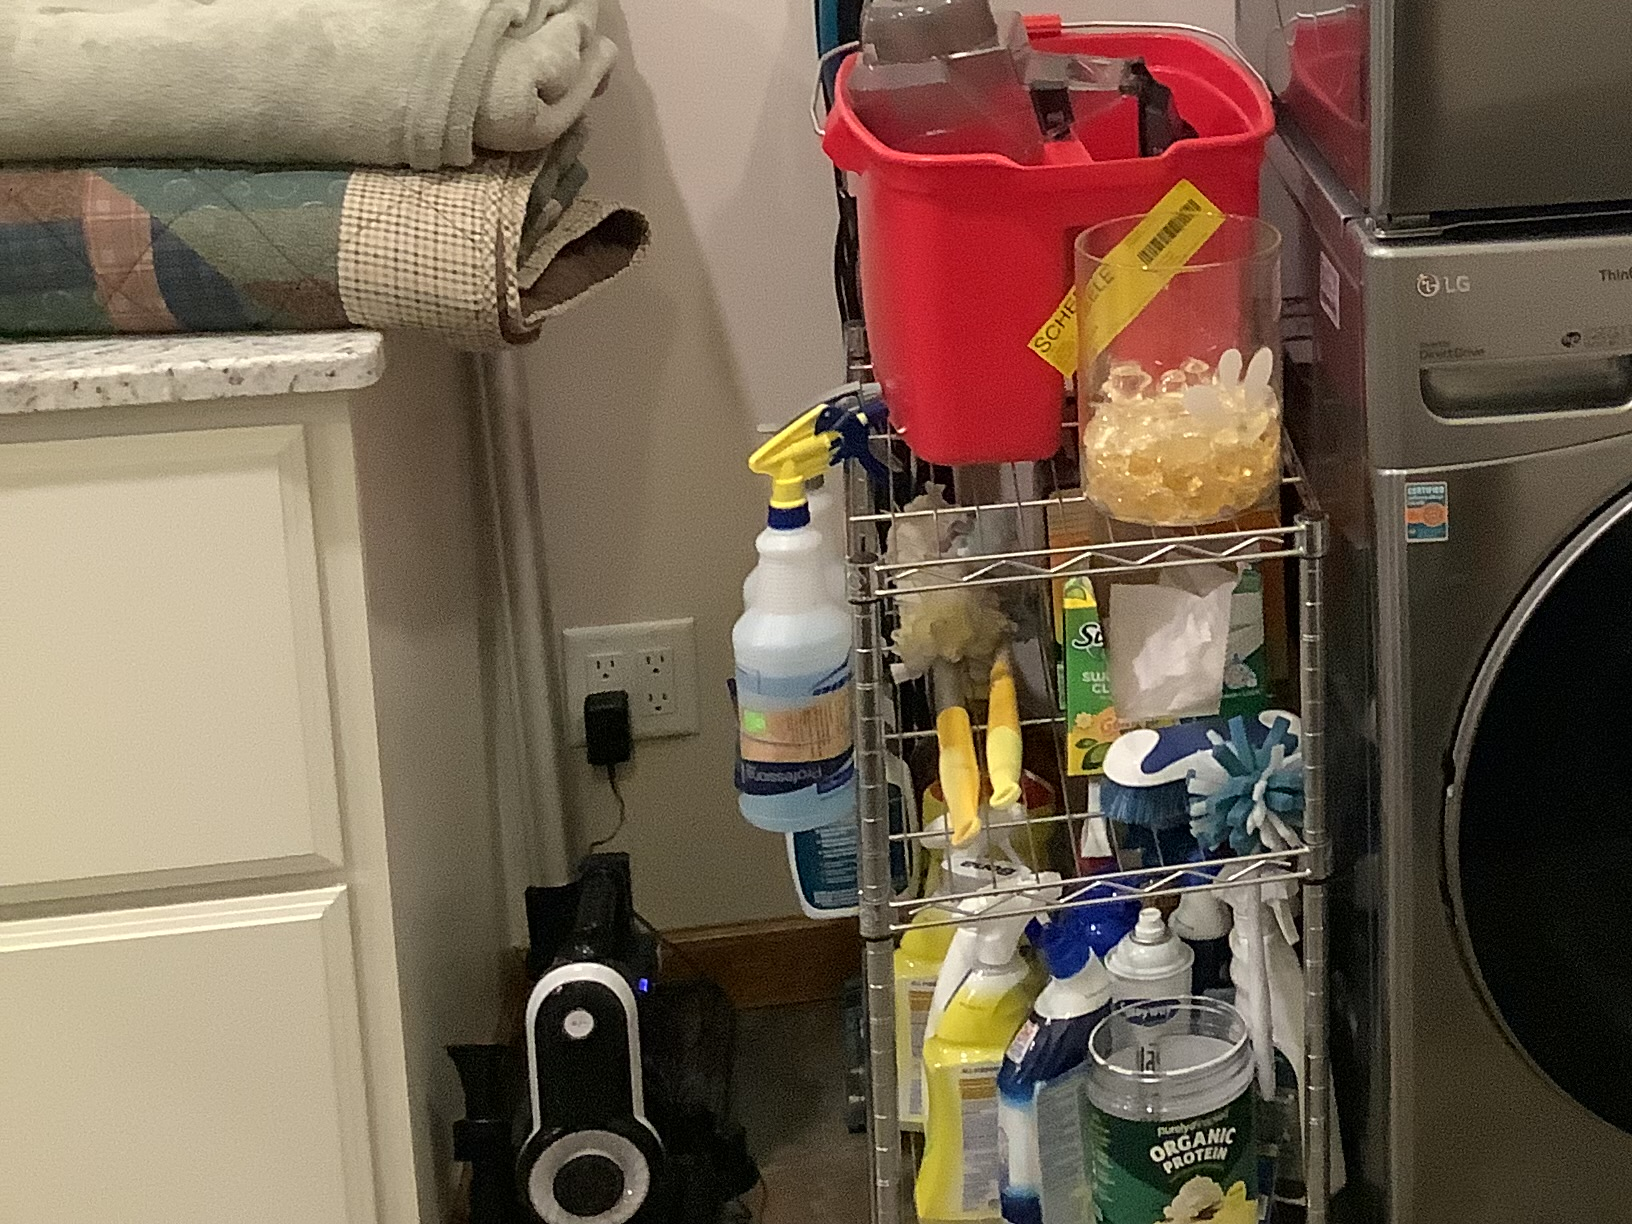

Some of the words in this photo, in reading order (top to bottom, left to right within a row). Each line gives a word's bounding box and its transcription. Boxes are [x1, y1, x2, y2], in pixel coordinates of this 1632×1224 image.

[1444, 276, 1470, 292] LG
[1149, 1126, 1237, 1163] ORGANIC
[1162, 1146, 1228, 1175] PROTEIN
